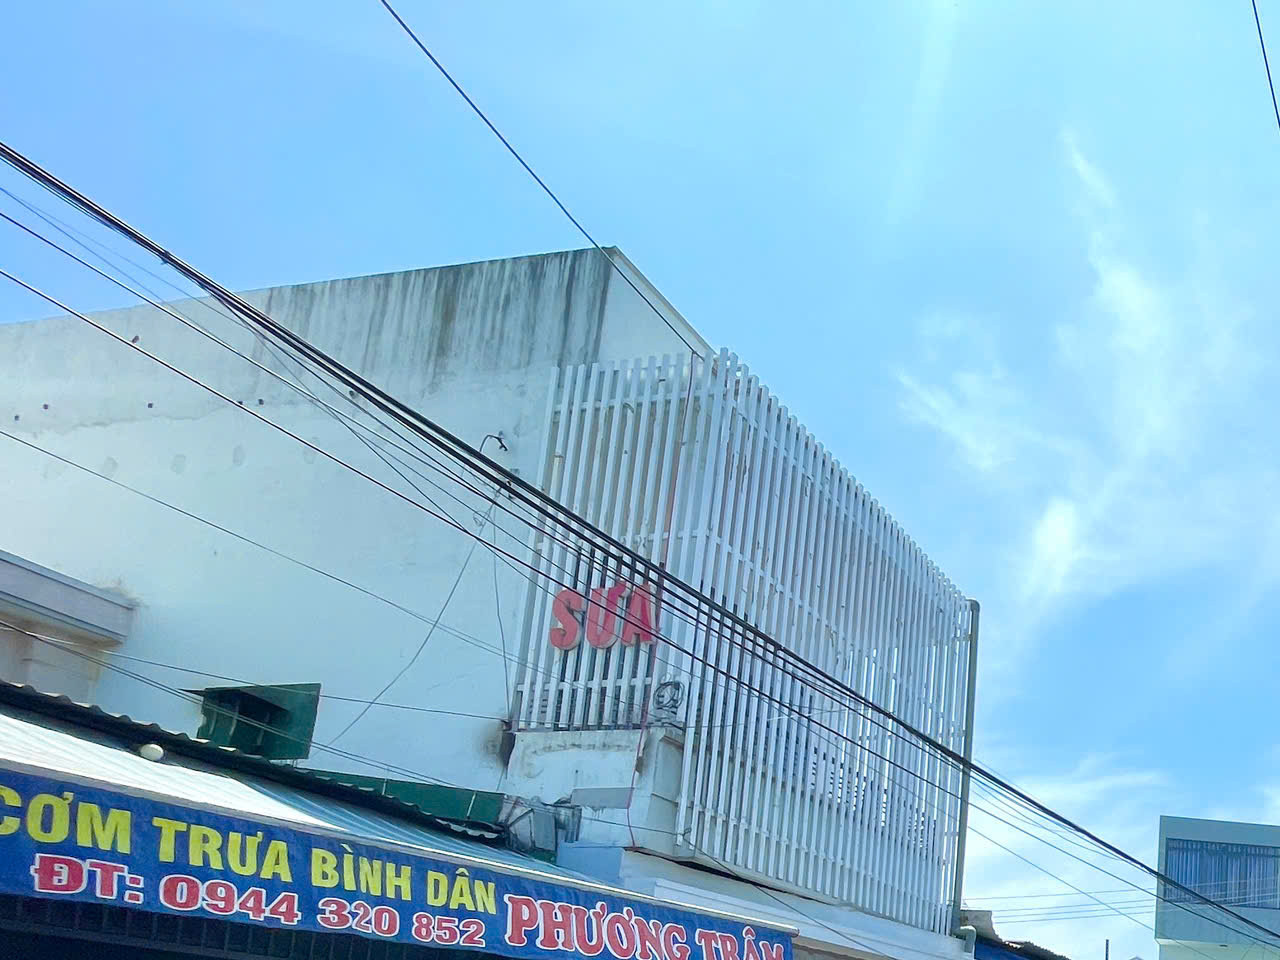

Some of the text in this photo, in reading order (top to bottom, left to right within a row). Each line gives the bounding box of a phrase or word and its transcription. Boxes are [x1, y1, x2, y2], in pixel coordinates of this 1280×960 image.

[0, 784, 497, 915] CƠM TRƯA BÌNH DÂN
[30, 852, 486, 947] ĐT: 0944 320 852
